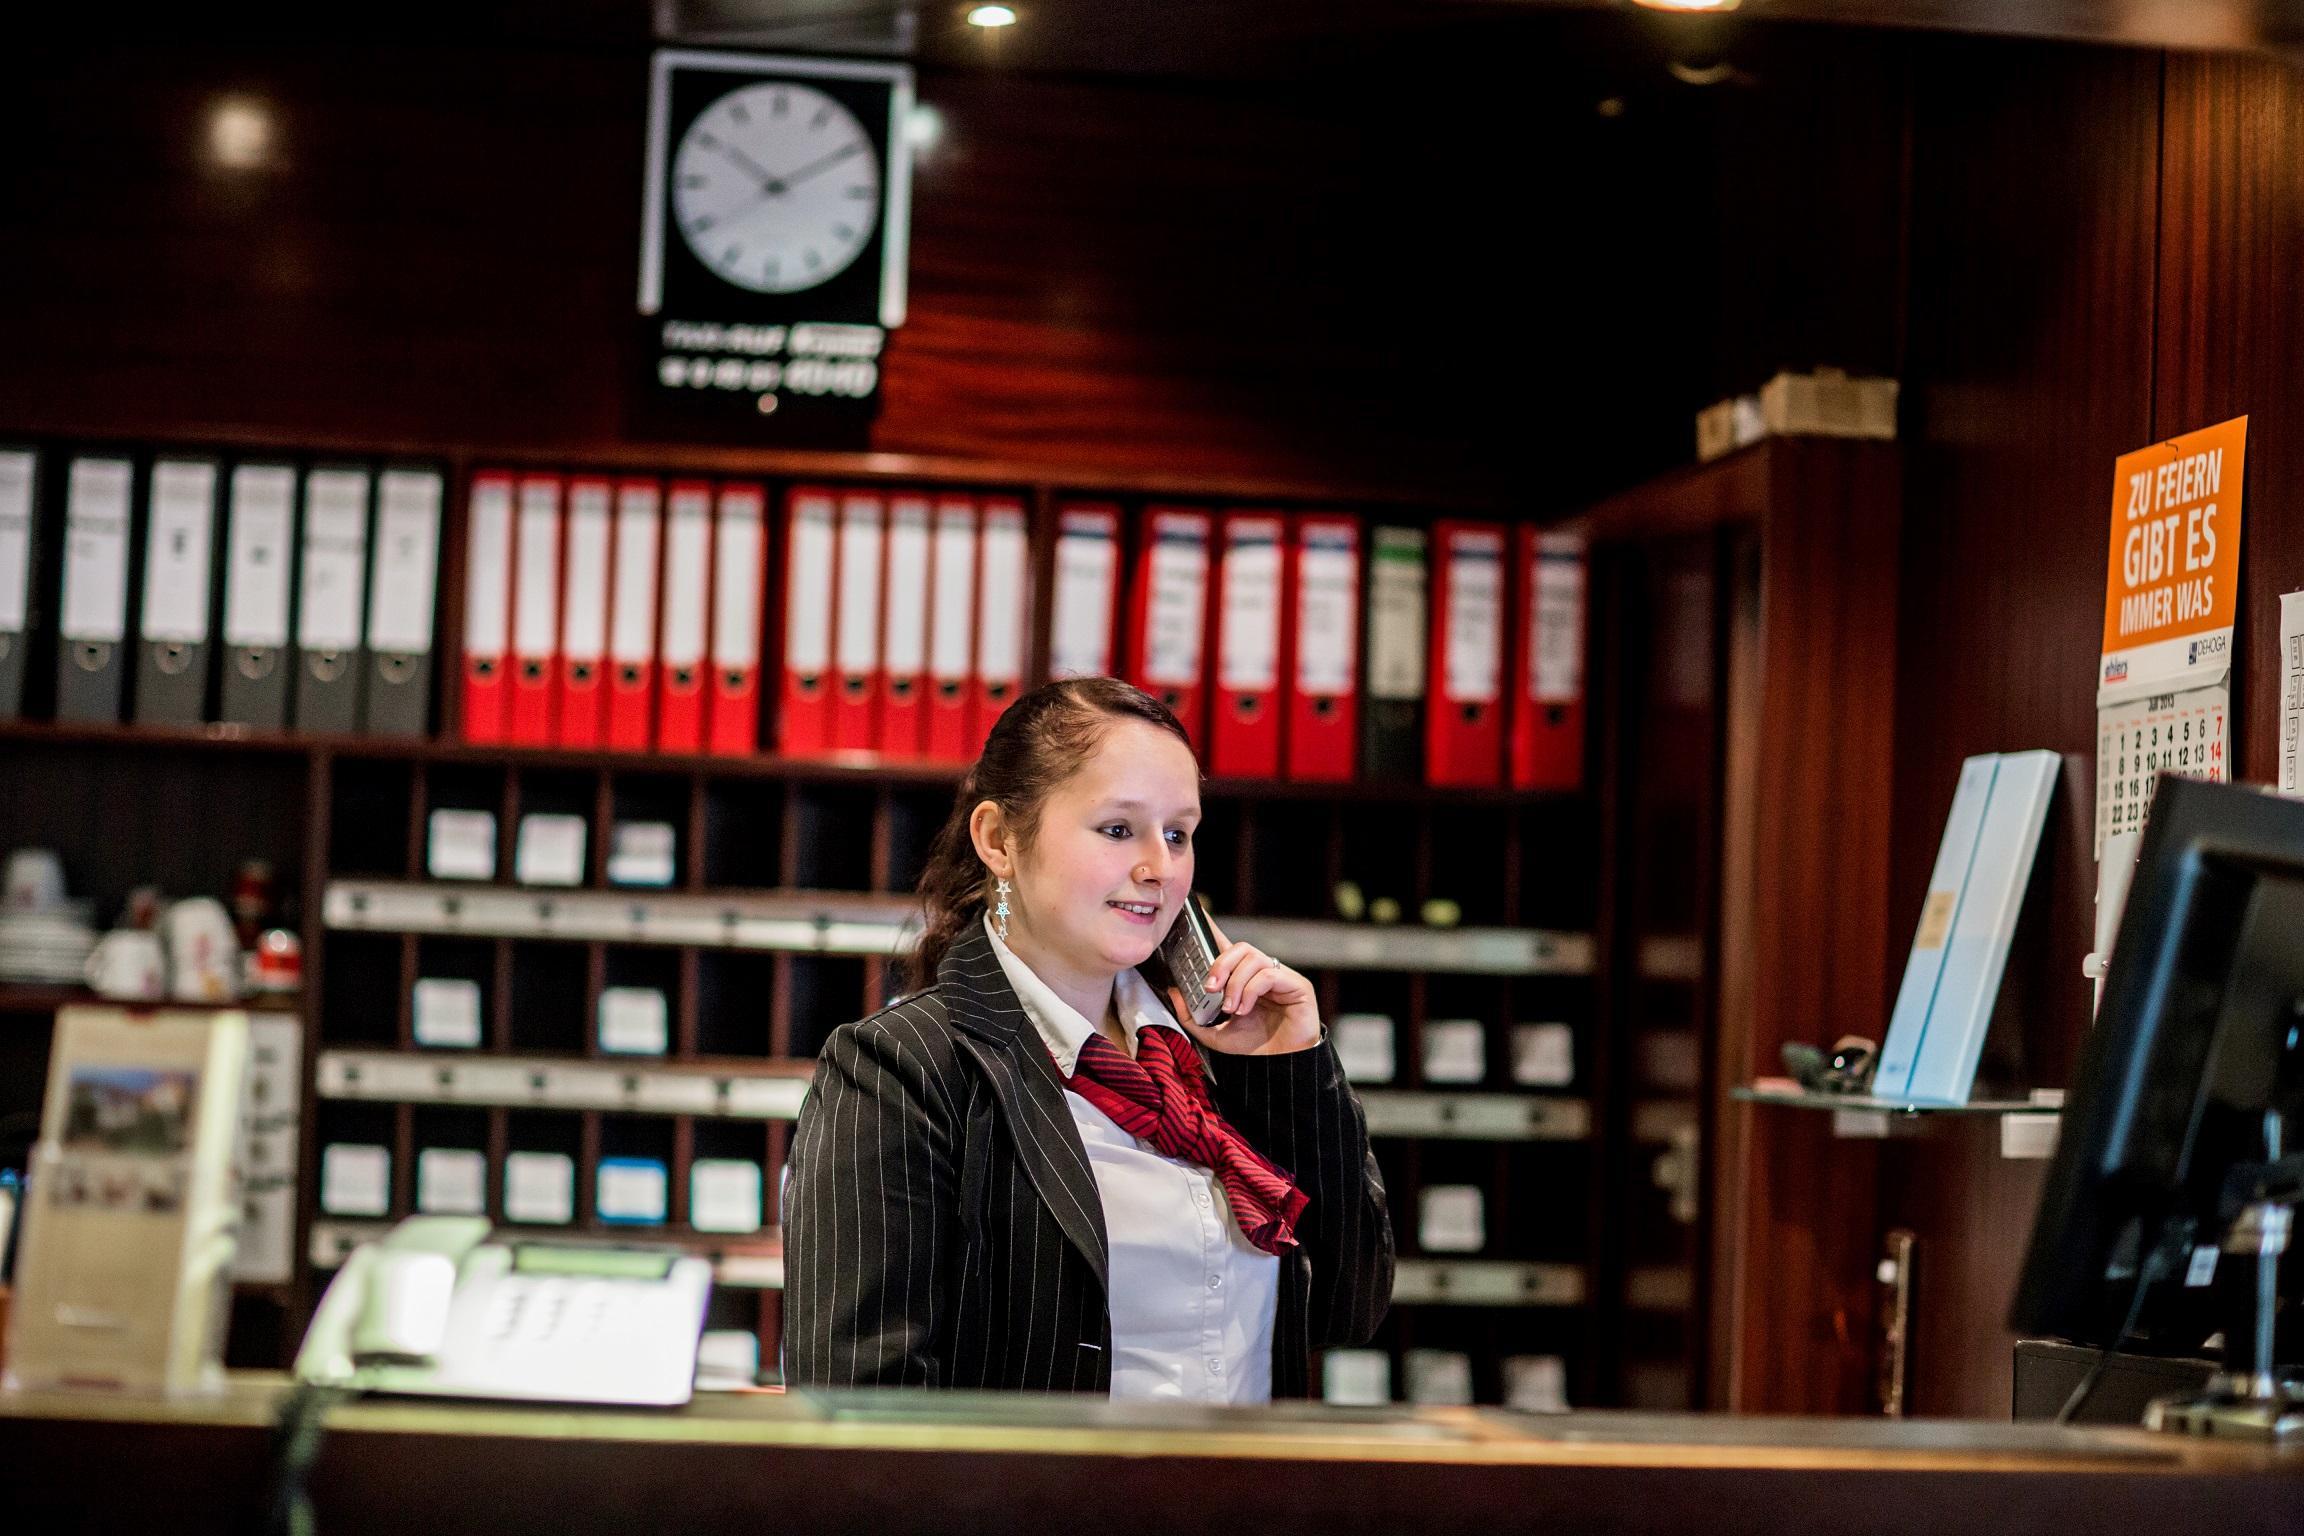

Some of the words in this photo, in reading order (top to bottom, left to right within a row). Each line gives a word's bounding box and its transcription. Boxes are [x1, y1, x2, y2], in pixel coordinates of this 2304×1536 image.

[2128, 470, 2153, 521] ZU
[2156, 448, 2223, 512] FEIERN
[2124, 515, 2180, 588] GIBT
[2187, 504, 2217, 572] ES
[2120, 587, 2172, 637] IMMER
[2177, 576, 2213, 623] WAS
[2197, 635, 2226, 657] DEHOGA
[2120, 734, 2125, 751] 1
[2135, 730, 2142, 749] 2
[2151, 728, 2158, 747] 3
[2167, 725, 2174, 744] 4
[2183, 722, 2190, 741] 5
[2199, 719, 2206, 738] 6
[2216, 716, 2223, 736] 7
[2118, 755, 2125, 776] 8
[2134, 754, 2141, 773] 9
[2146, 752, 2157, 771] 10
[2163, 748, 2172, 768] 11
[2178, 746, 2188, 766] 12
[2194, 743, 2205, 763] 13
[2210, 741, 2222, 761] 14
[2114, 780, 2124, 799] 15
[2129, 779, 2139, 797] 16
[2145, 776, 2155, 796] 17
[2209, 765, 2221, 783] 21
[2112, 804, 2122, 823] 22
[2127, 802, 2139, 821] 23
